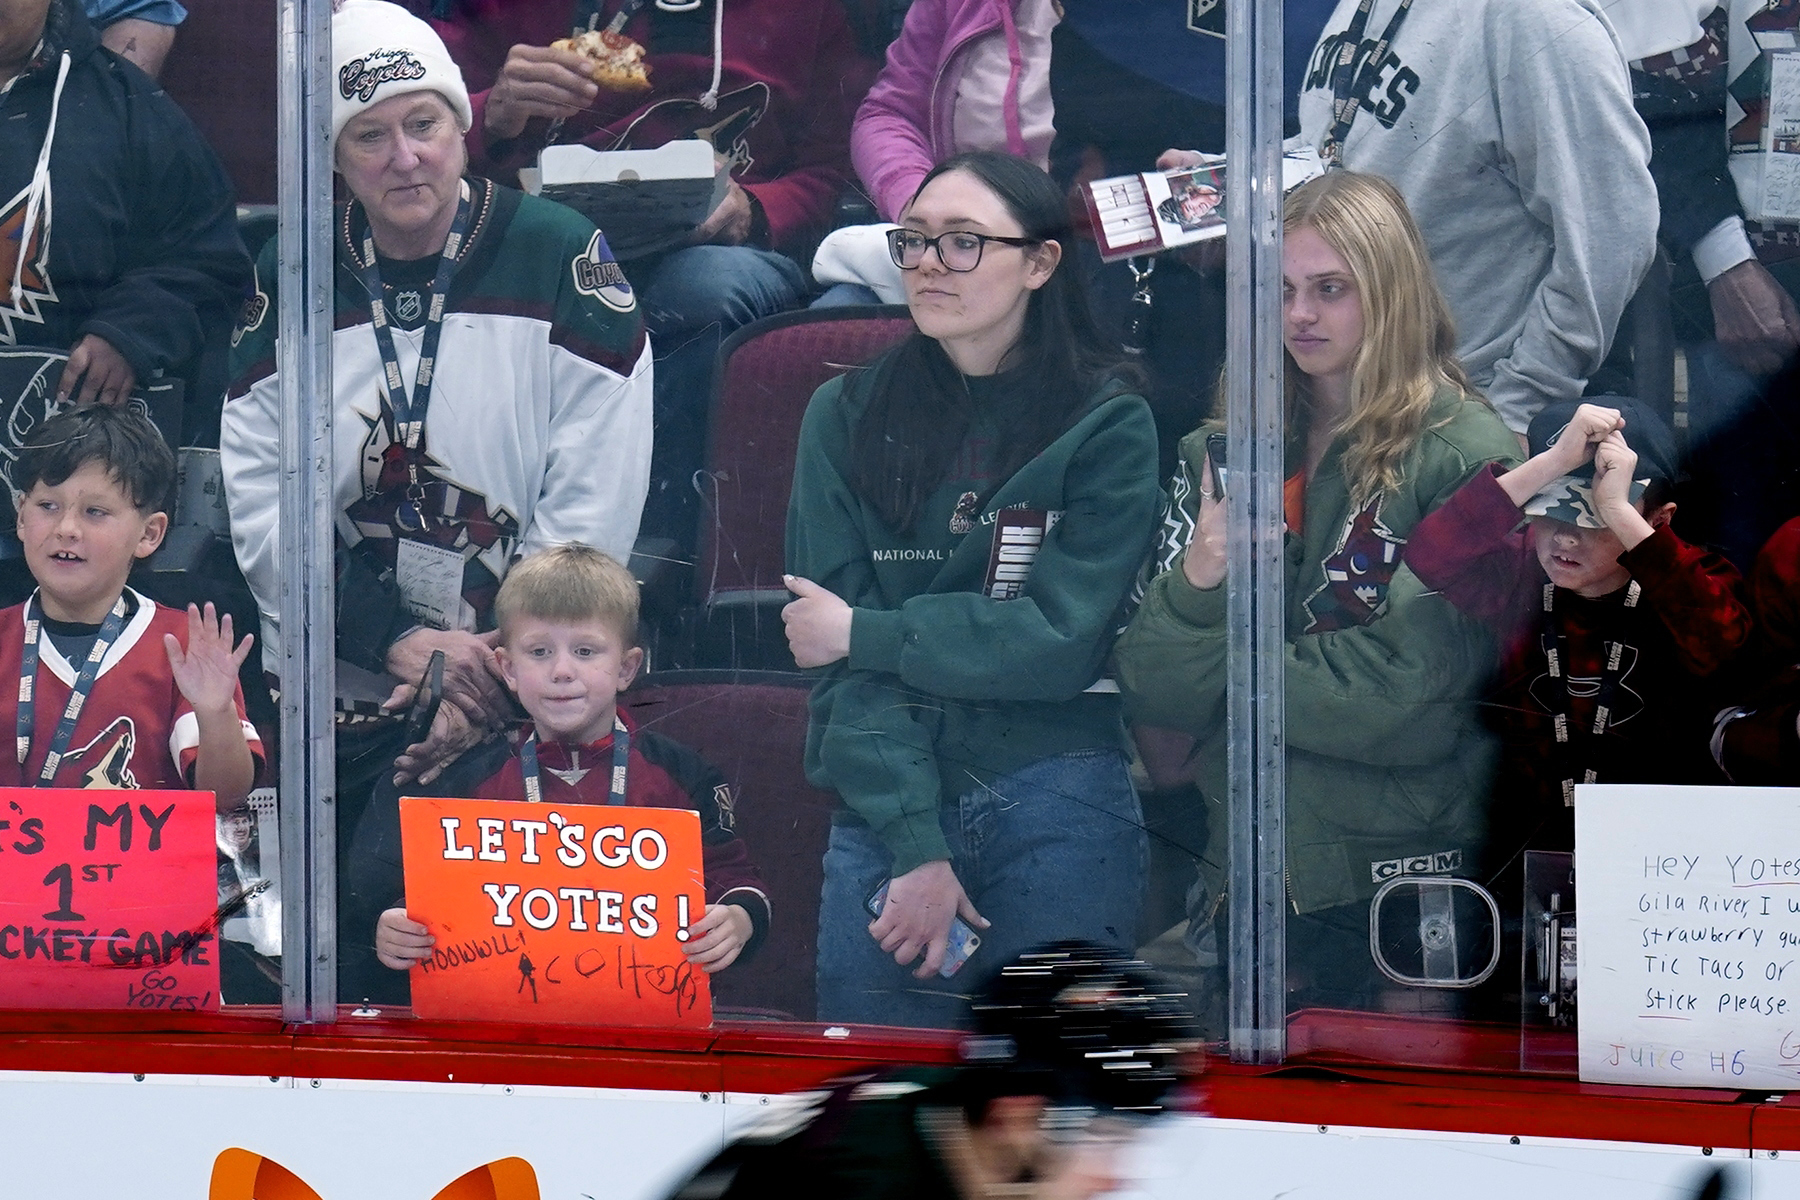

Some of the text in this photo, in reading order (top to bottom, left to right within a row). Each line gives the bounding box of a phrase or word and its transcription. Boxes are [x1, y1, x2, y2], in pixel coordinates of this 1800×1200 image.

[339, 57, 426, 102] Coyotes
[873, 549, 944, 561] NATIONAL
[84, 803, 176, 852] MY
[1374, 849, 1461, 881] CCM
[1638, 892, 1685, 913] Gila
[1698, 893, 1751, 918] River,
[1759, 896, 1772, 915] I
[107, 930, 216, 966] GAME
[142, 970, 178, 991] GO
[1644, 954, 1679, 975] Tic
[1698, 956, 1745, 980] Tacs
[1608, 1043, 1685, 1072] Juice
